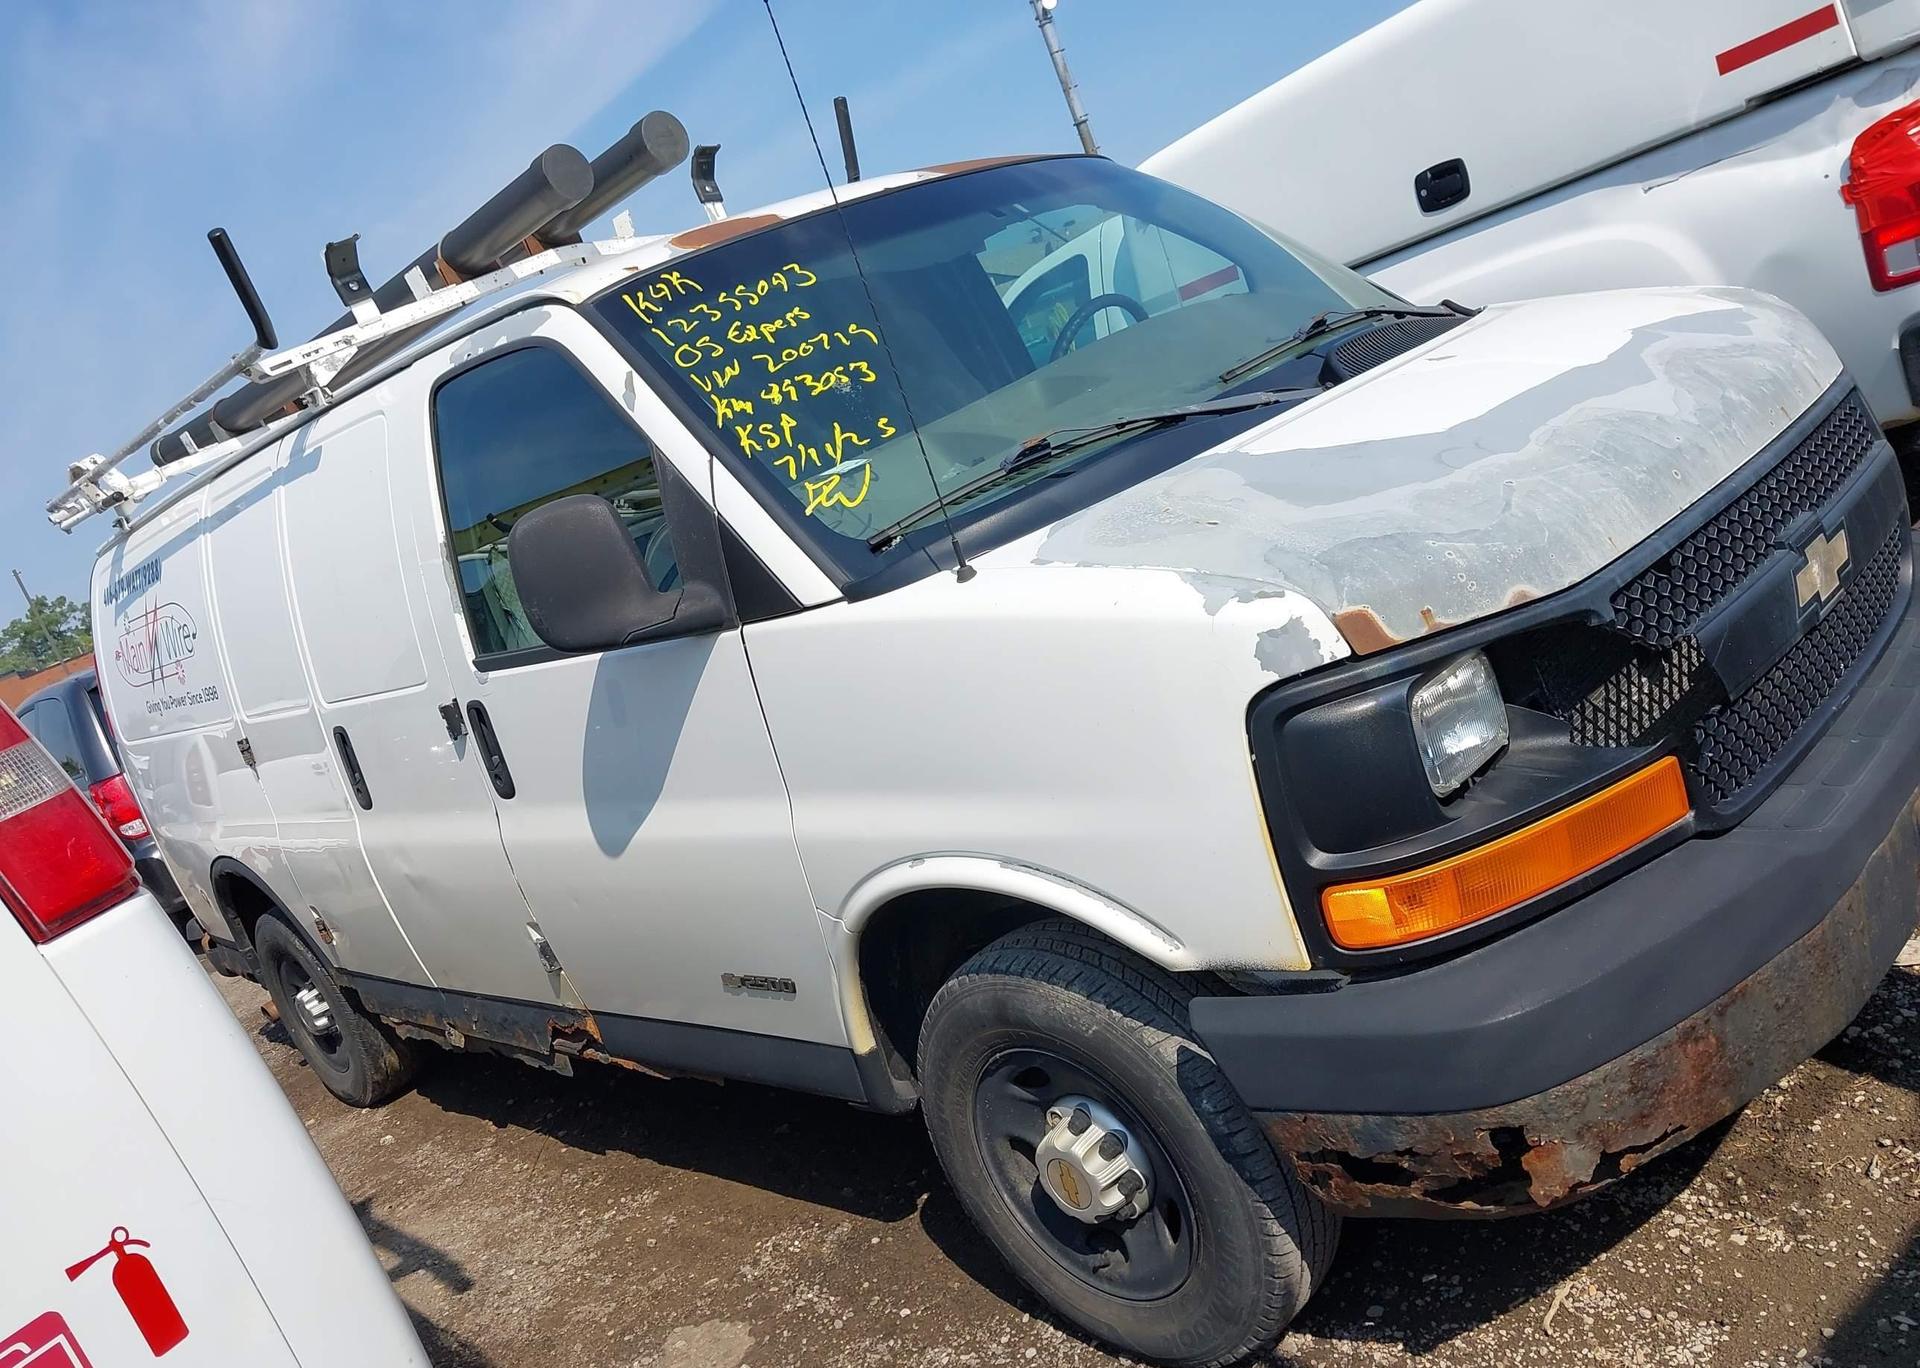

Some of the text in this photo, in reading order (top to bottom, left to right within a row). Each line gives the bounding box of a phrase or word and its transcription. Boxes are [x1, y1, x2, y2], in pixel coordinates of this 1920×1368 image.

[119, 616, 195, 676] Main Wire
[146, 685, 219, 717] Giving You Power Since 1998
